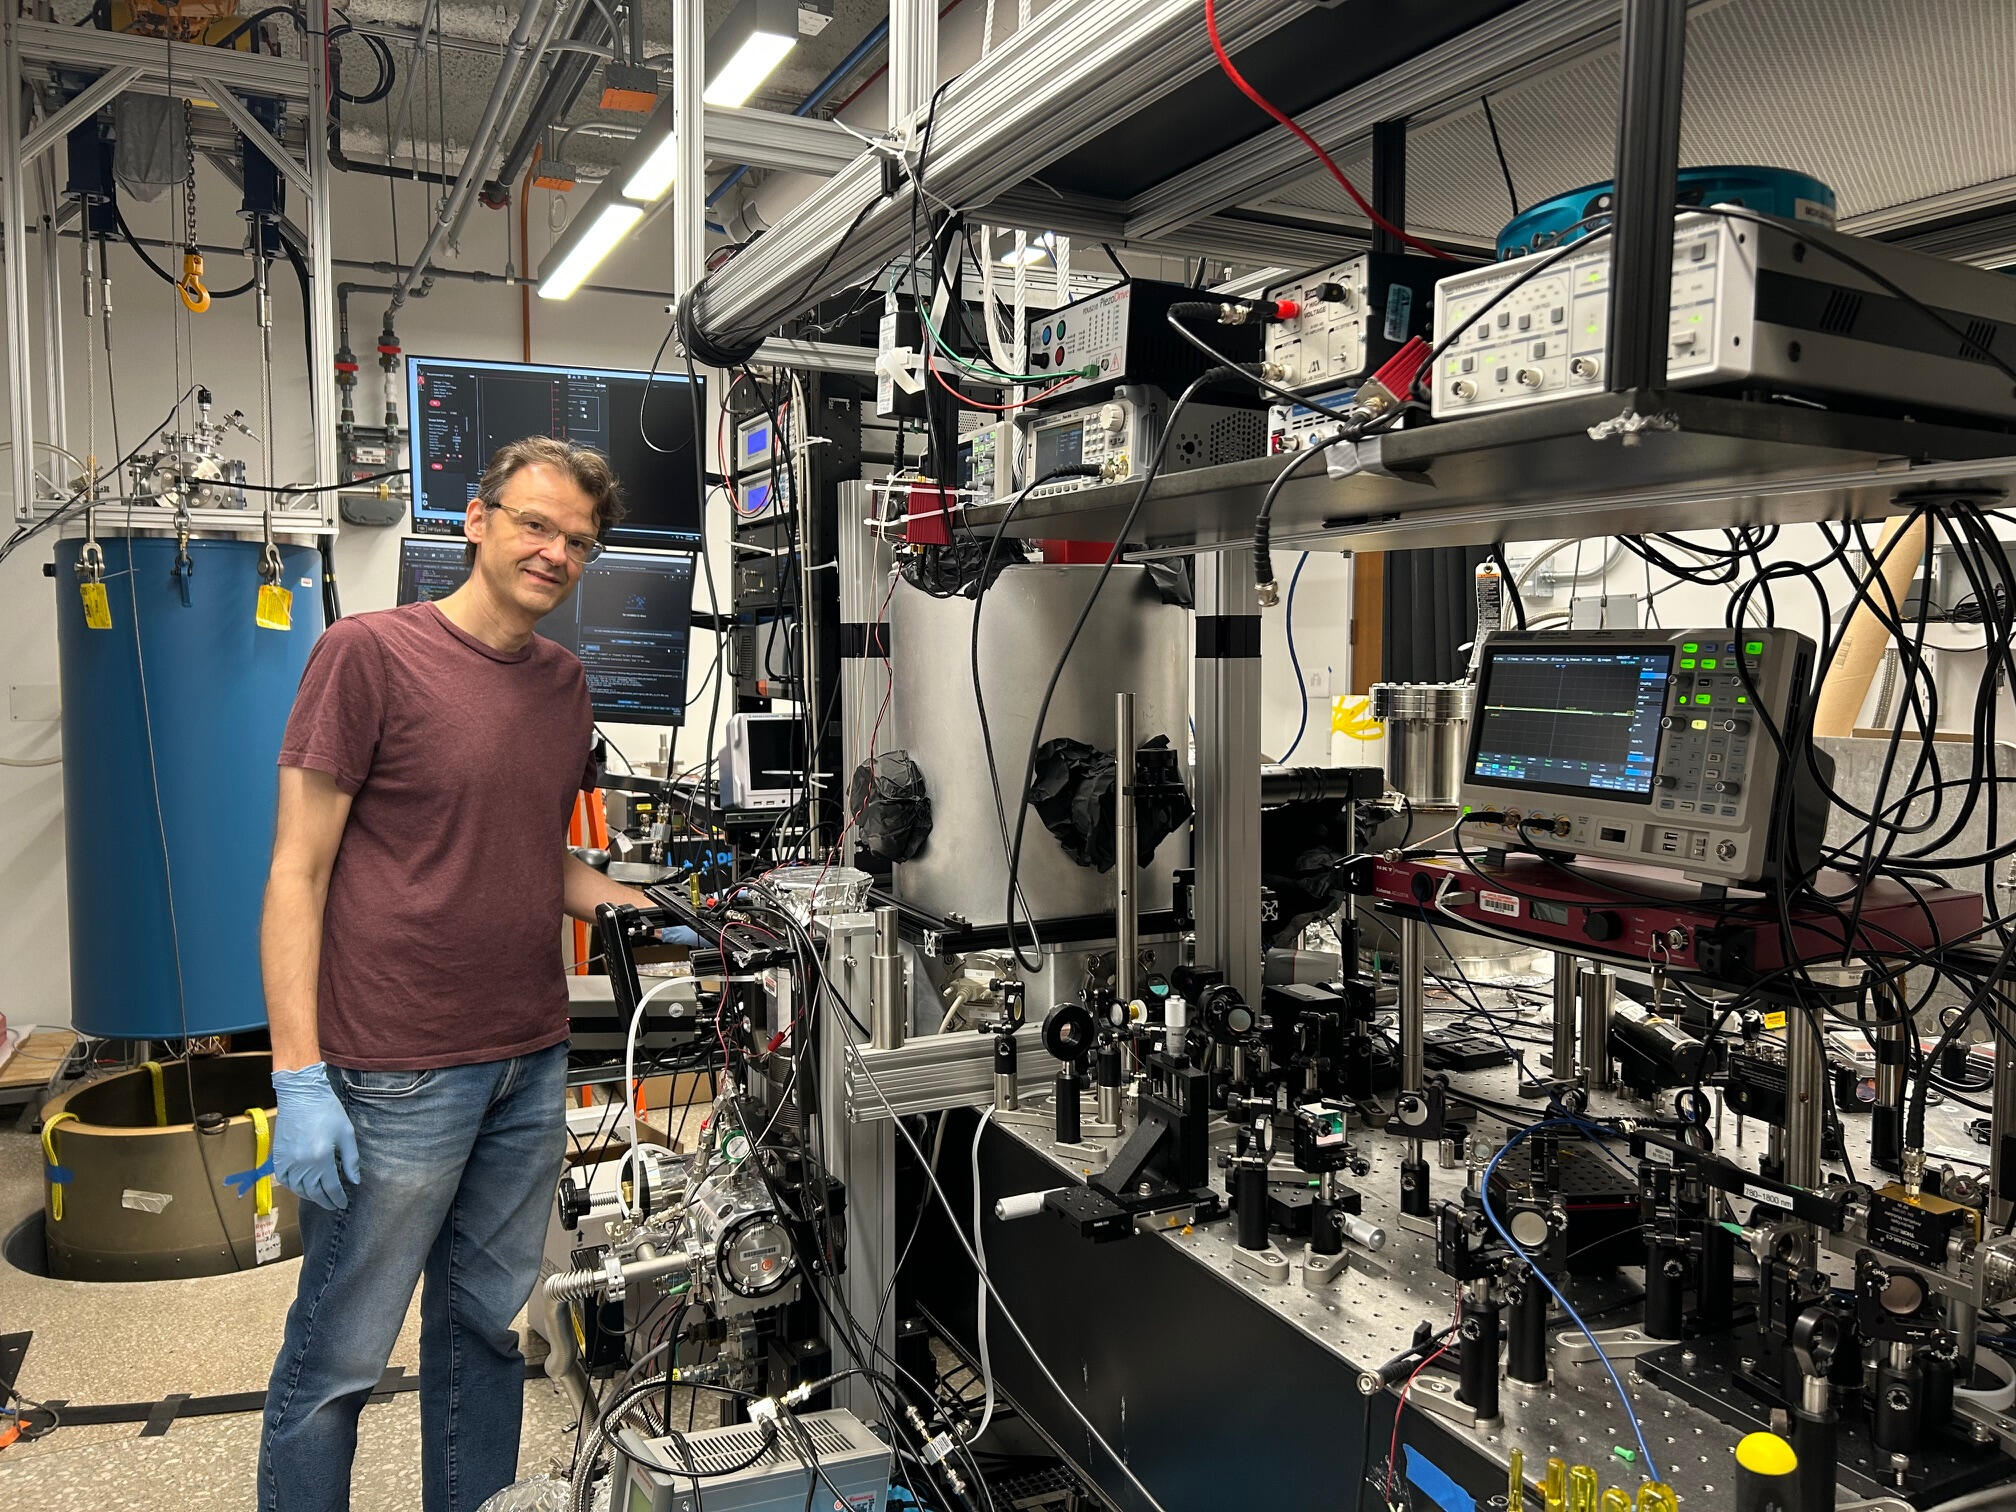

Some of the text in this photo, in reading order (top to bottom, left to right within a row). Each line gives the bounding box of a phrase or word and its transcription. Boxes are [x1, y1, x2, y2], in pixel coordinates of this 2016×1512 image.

[1100, 289, 1129, 309] PiezoDrive
[1304, 305, 1327, 319] VOLTAGE
[1376, 865, 1392, 873] NKT
[1781, 1200, 1792, 1208] nm
